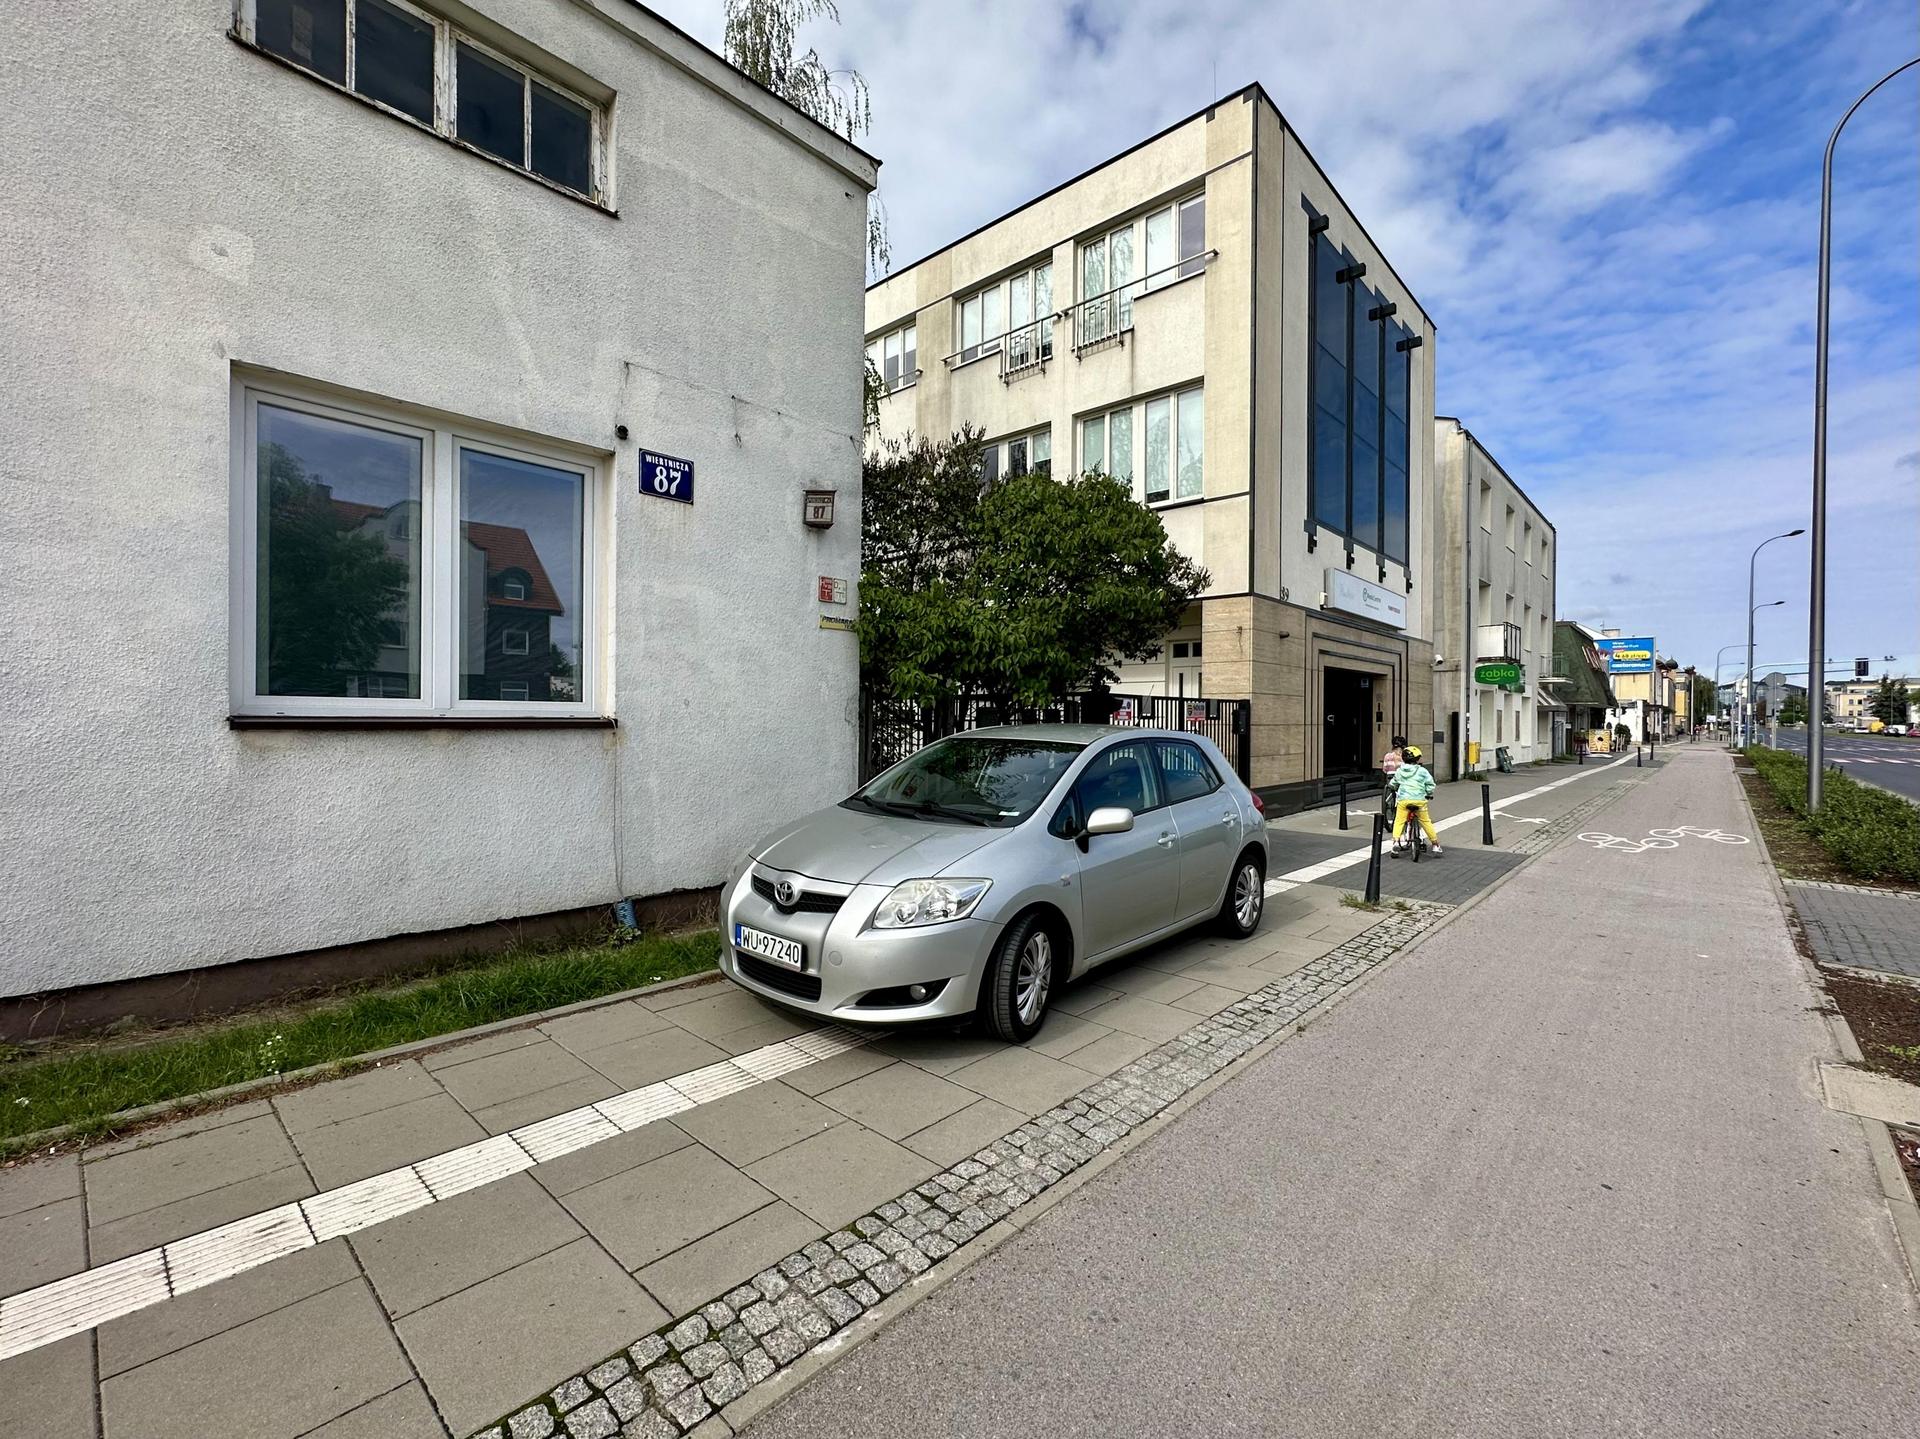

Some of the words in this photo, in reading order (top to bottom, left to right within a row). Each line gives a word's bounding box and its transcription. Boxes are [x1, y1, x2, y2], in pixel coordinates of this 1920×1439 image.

[645, 454, 689, 472] WIERTNICZA
[654, 466, 681, 495] 87
[813, 506, 826, 519] 87
[763, 936, 799, 963] 97240
